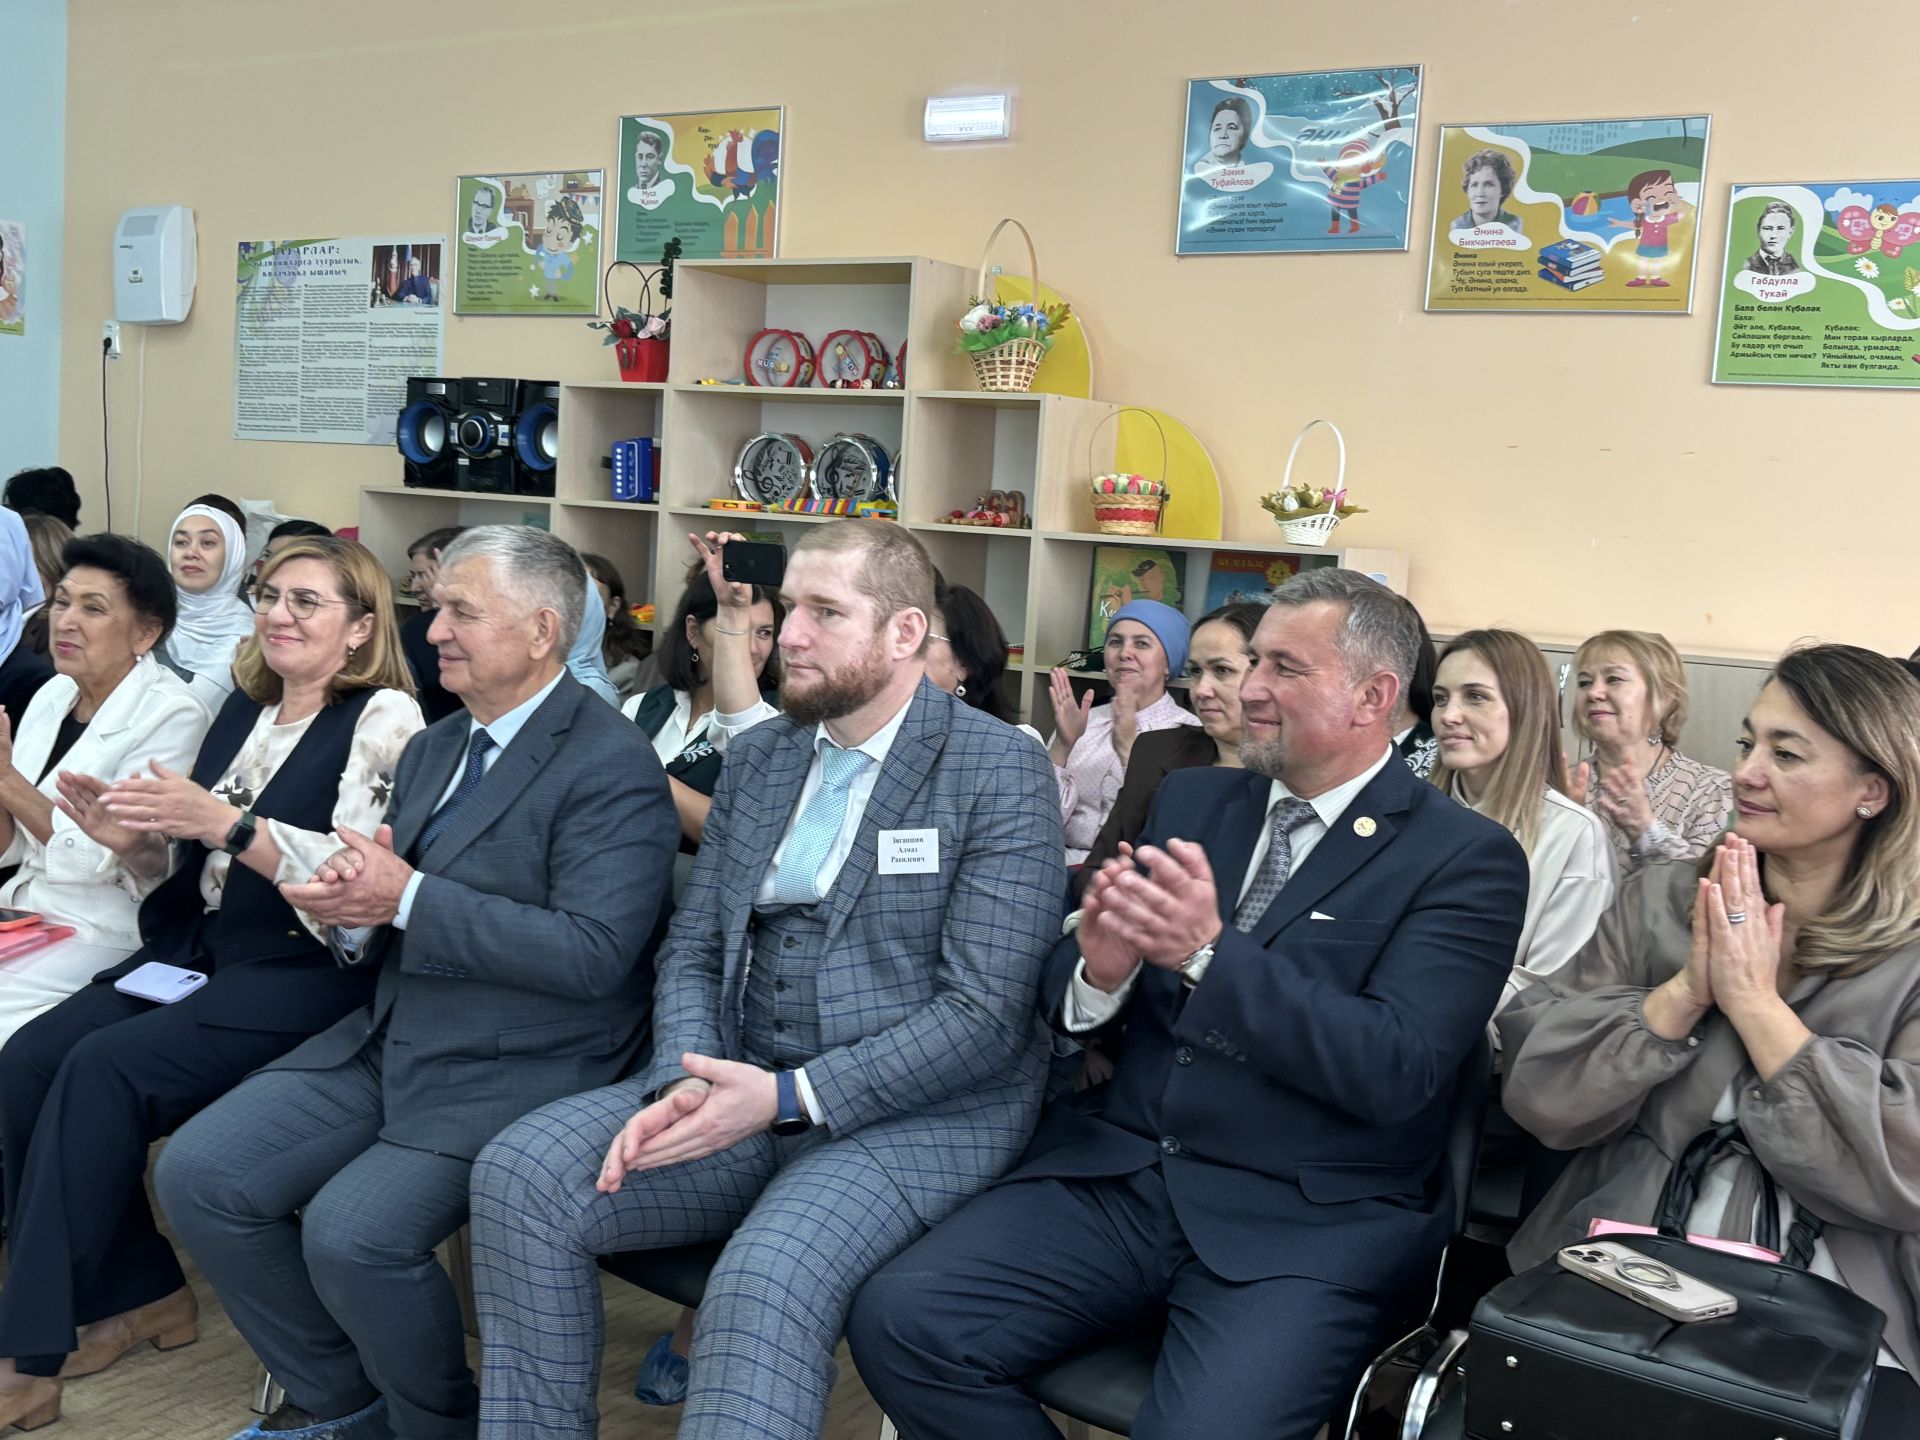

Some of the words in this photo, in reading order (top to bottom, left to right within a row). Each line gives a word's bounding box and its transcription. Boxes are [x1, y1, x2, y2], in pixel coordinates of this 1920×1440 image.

[1221, 168, 1245, 176] Закия
[1211, 178, 1254, 188] Туфайлова
[642, 190, 657, 199] Муса
[1474, 227, 1504, 236] Әминә
[1751, 277, 1799, 286] Габдулла
[1759, 290, 1788, 299] Тукай
[1734, 304, 1755, 312] Бала
[1757, 304, 1783, 312] белән
[1785, 304, 1821, 313] Күбәләк
[1730, 342, 1741, 350] Бу
[1742, 343, 1766, 351] кадәр
